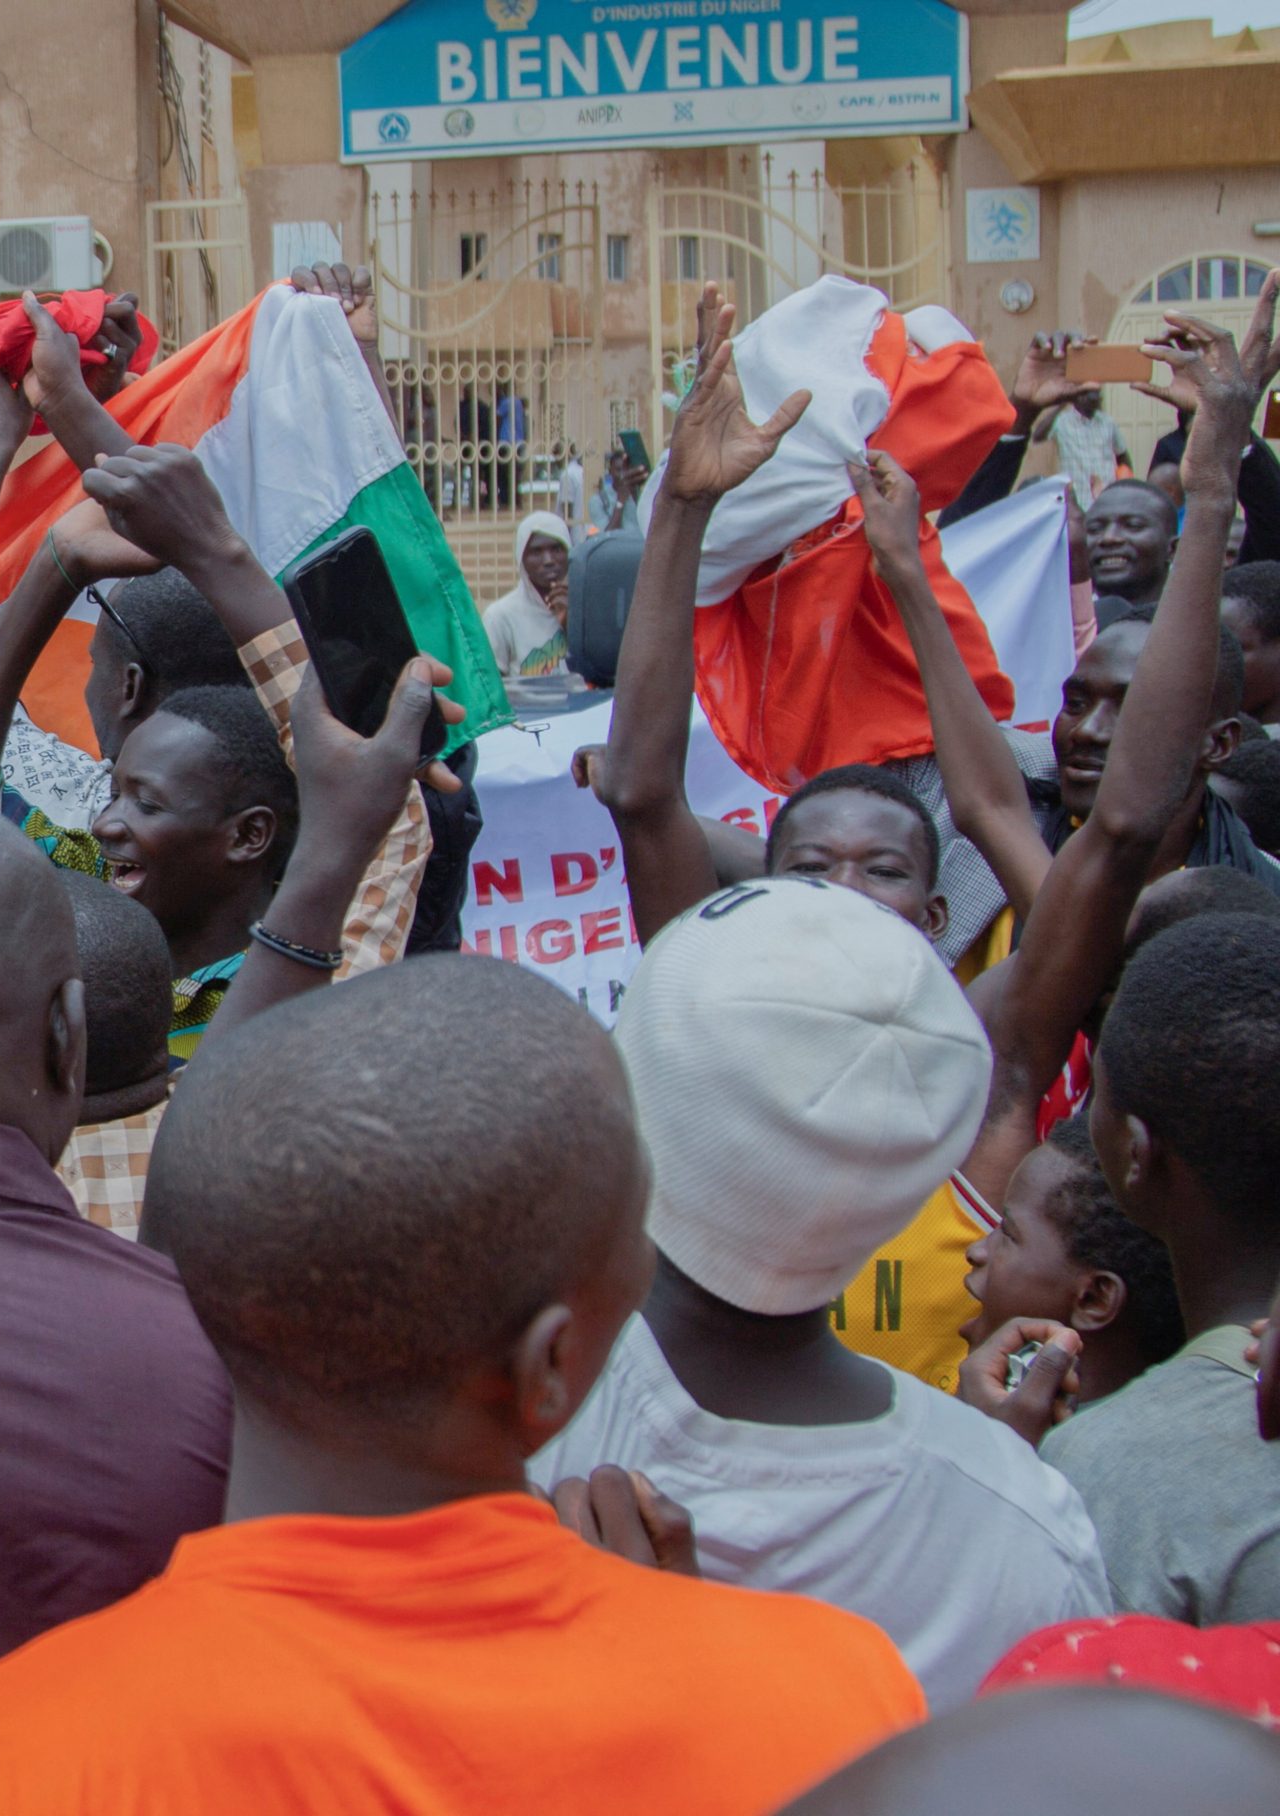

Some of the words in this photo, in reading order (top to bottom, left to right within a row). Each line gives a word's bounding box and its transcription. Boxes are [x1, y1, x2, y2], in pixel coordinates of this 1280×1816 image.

[592, 2, 697, 22] D'INDUSTRIE
[702, 0, 727, 16] DU
[730, 0, 781, 14] NIGER
[437, 16, 859, 104] BIENVENUE
[551, 847, 627, 897] D'
[461, 907, 639, 965] IGE
